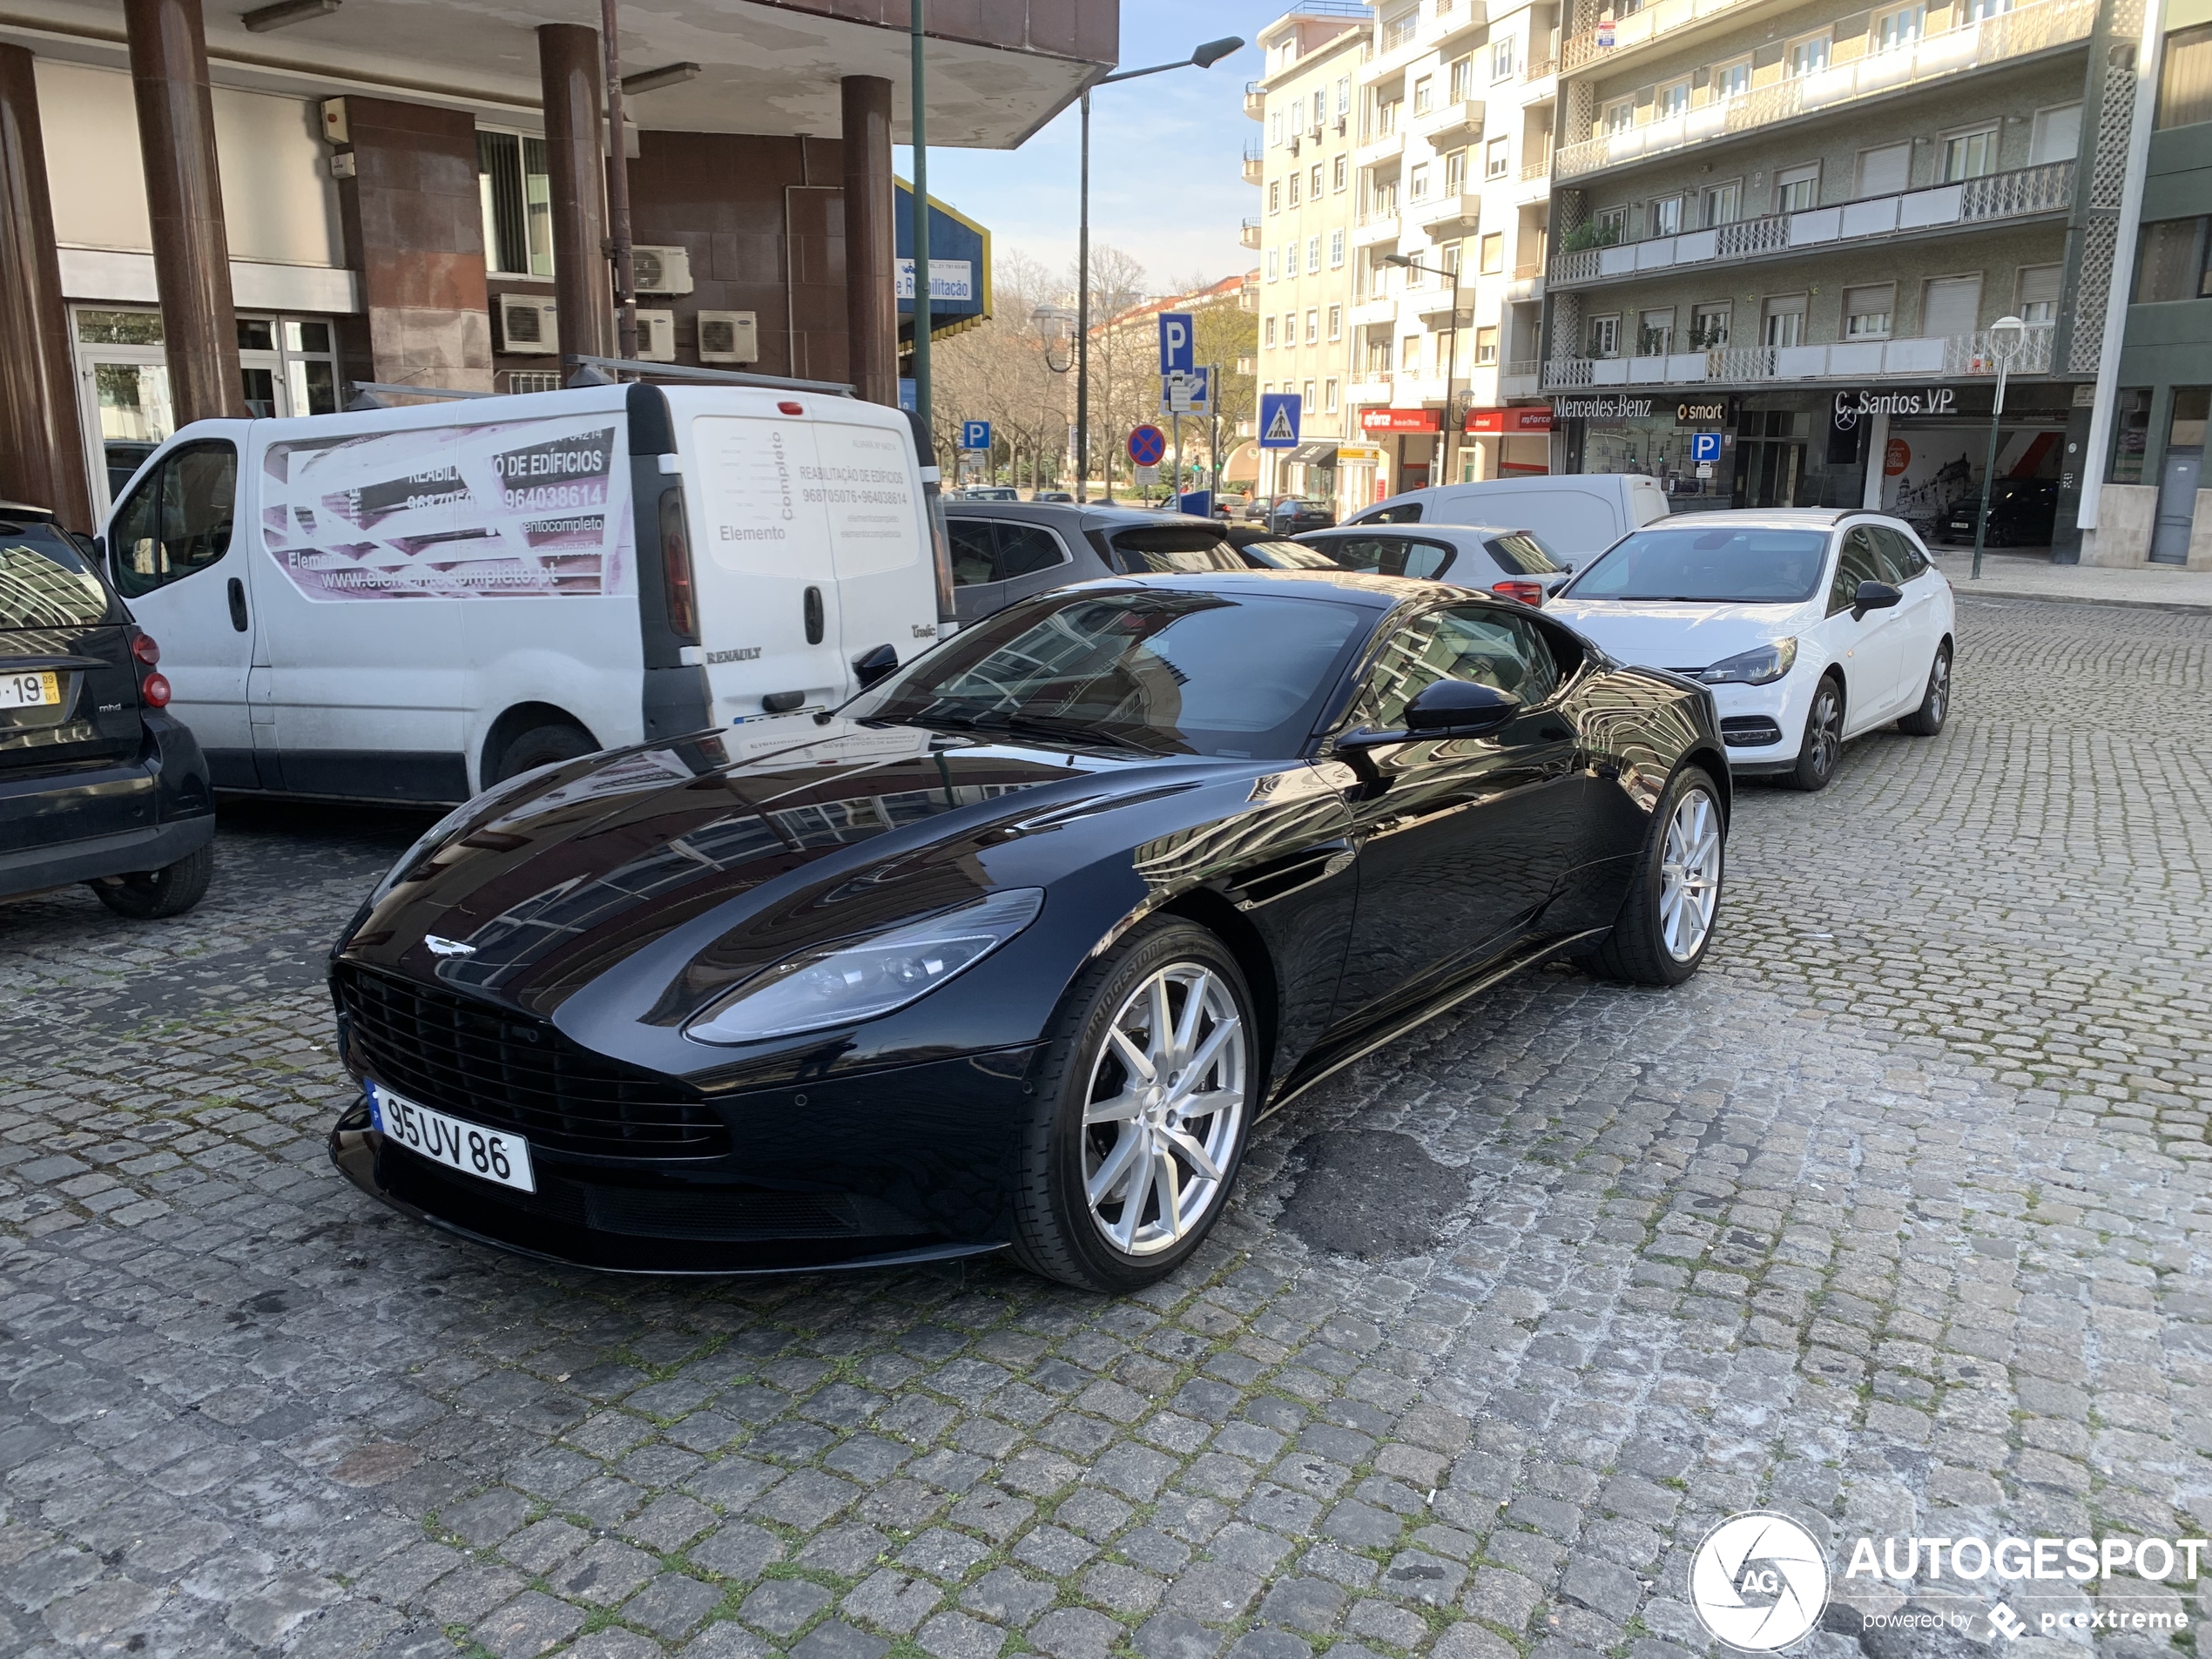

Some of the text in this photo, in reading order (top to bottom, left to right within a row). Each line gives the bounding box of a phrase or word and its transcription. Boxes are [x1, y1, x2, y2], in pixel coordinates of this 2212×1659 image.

[1166, 321, 1186, 367] P
[1553, 394, 1652, 417] Mercedes-Benz
[1688, 402, 1723, 420] smart
[1835, 388, 1954, 415] C. Santos VP
[968, 424, 985, 445] P
[1697, 435, 1715, 458] P
[509, 455, 527, 476] DE
[530, 446, 603, 475] EDÍFICIOS
[772, 431, 793, 521] Completo
[799, 465, 859, 484] REABILITAÇÃO
[860, 469, 871, 482] DE
[505, 484, 603, 510] 964038614
[521, 516, 604, 536] entocompleto
[719, 525, 786, 541] Elemento
[912, 624, 936, 638] Trafic
[706, 647, 762, 664] RENAULT
[98, 703, 121, 713] mhd
[1085, 938, 1166, 1042] BRIDGESTONE
